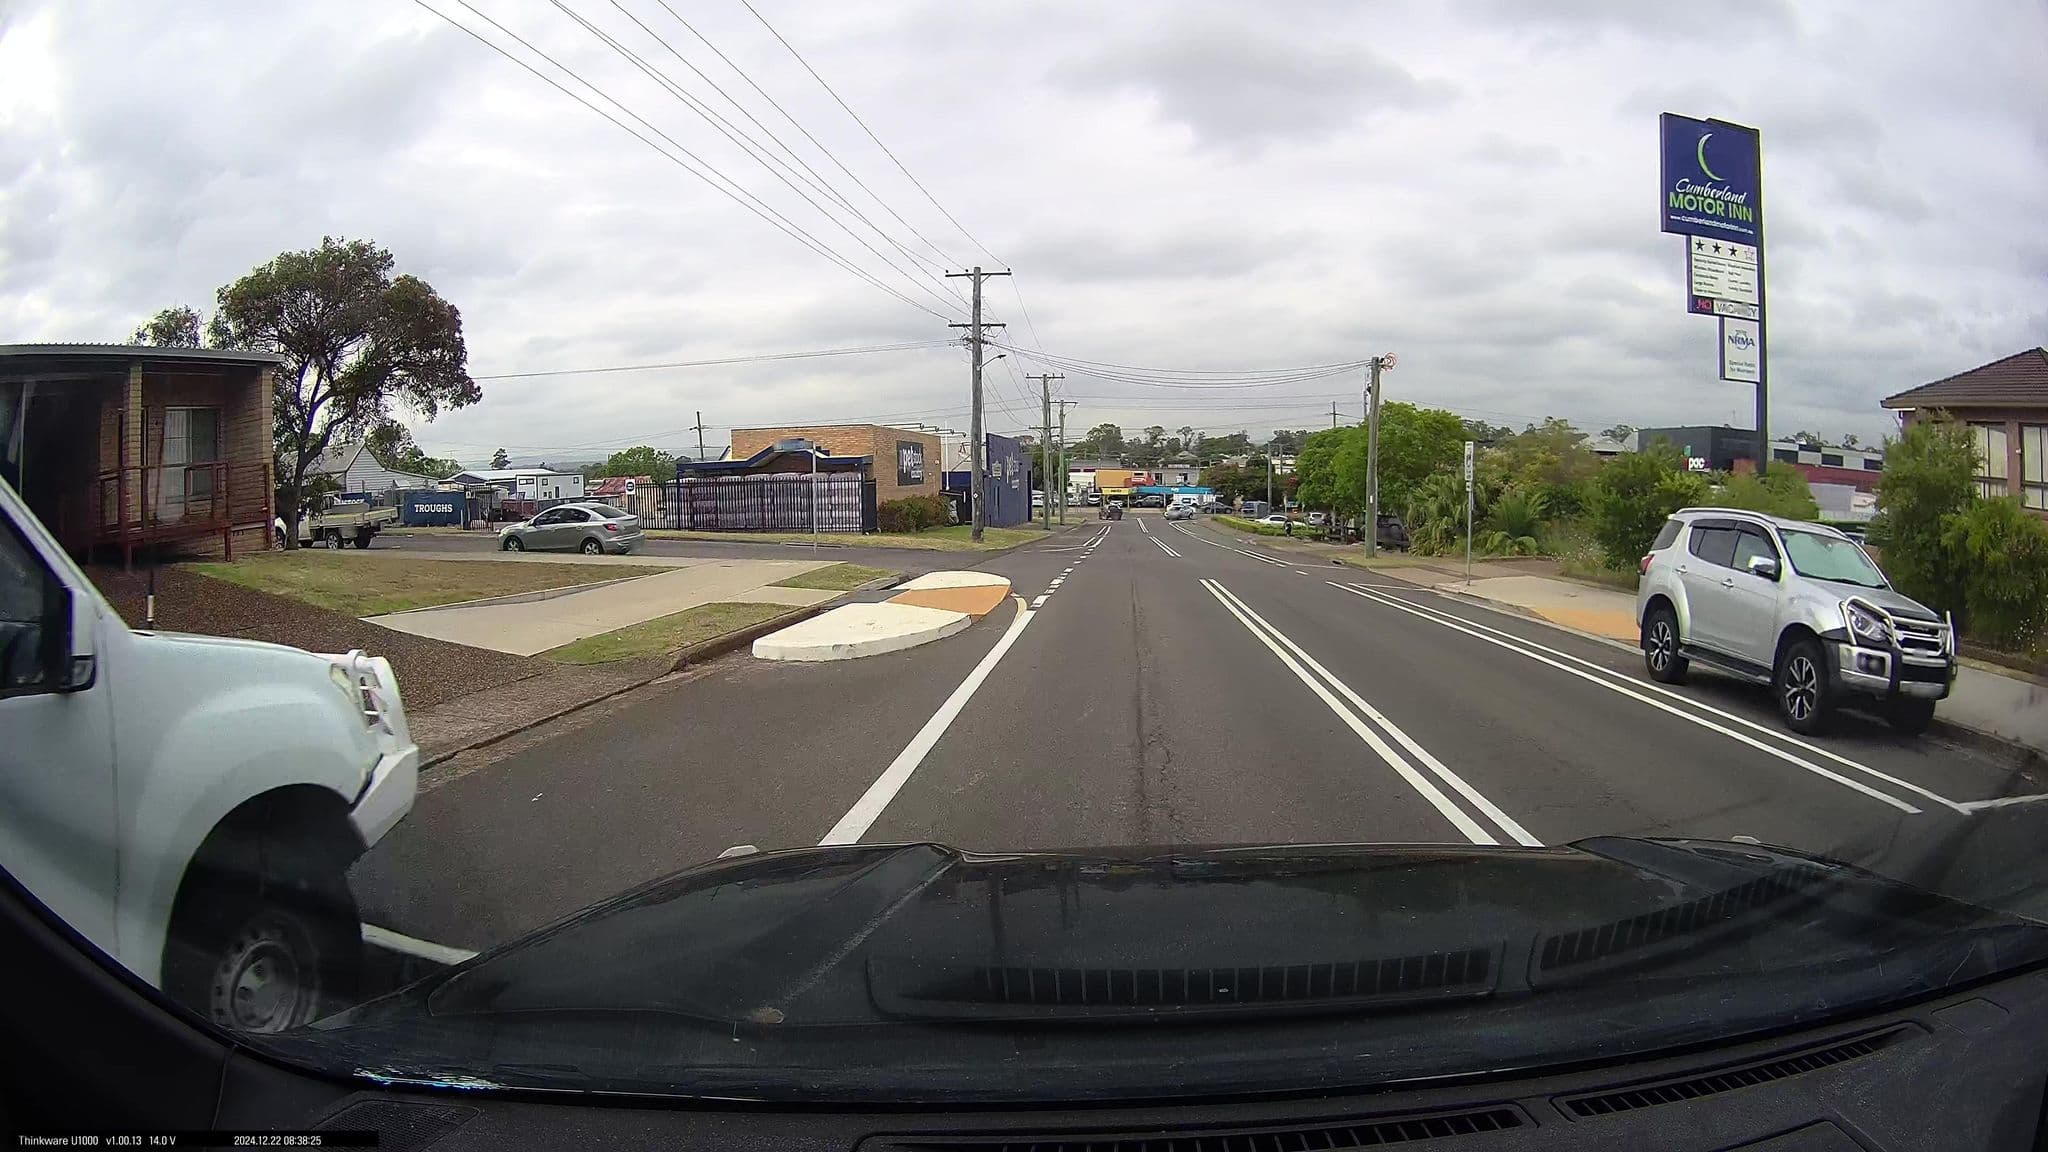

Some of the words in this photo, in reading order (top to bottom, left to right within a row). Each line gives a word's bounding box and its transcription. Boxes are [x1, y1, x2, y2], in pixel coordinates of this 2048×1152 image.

[1675, 178, 1747, 204] Cumberland
[1670, 192, 1725, 216] MOTOR
[1729, 203, 1753, 222] INN
[1716, 302, 1757, 317] VACY
[1728, 335, 1755, 347] NRMA
[414, 504, 453, 513] TROUGHS
